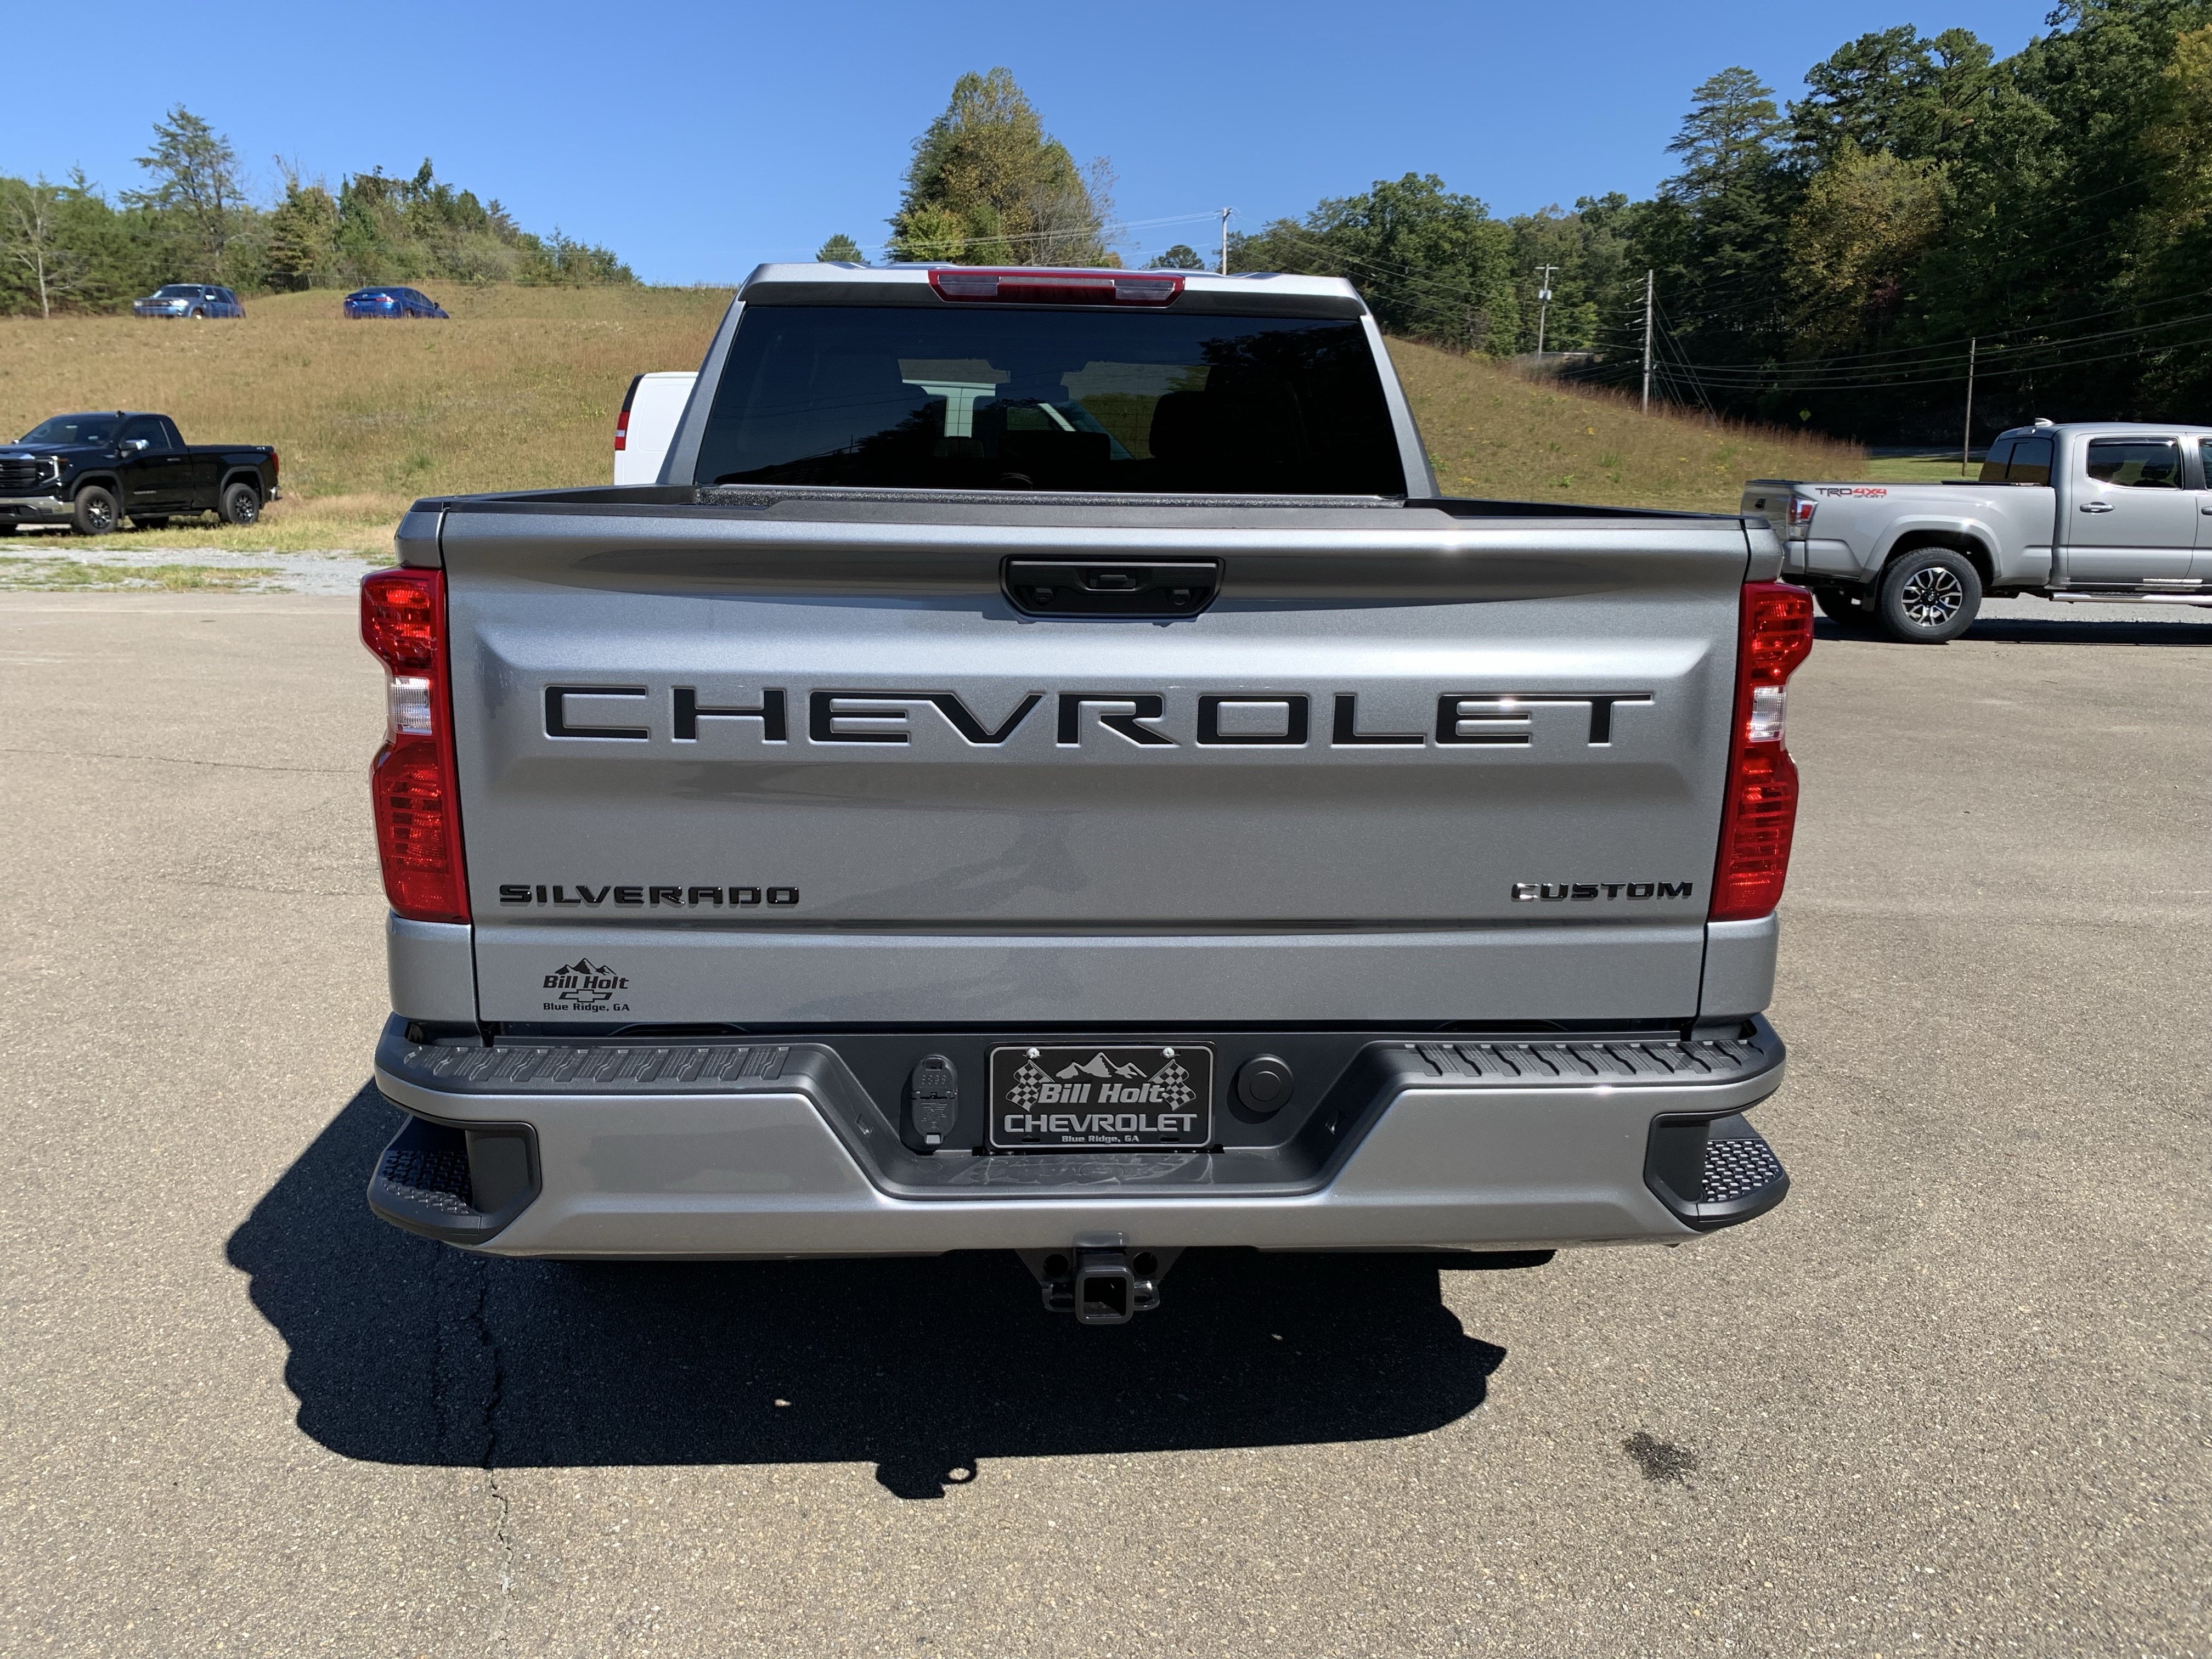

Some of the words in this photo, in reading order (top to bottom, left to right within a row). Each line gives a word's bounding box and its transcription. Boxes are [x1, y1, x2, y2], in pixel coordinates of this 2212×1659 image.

[1815, 488, 1853, 497] TRD
[545, 685, 1652, 747] CHEVROLET
[499, 884, 799, 905] SILVERADO
[1511, 881, 1693, 900] CUSTOM
[543, 975, 578, 988] Bill
[583, 976, 629, 989] Holt
[573, 1003, 609, 1012] Ridge,
[1038, 1084, 1091, 1103] Bill
[1098, 1084, 1165, 1103] Holt
[1004, 1114, 1197, 1132] CHEVROLET
[1088, 1135, 1121, 1143] Ridge,
